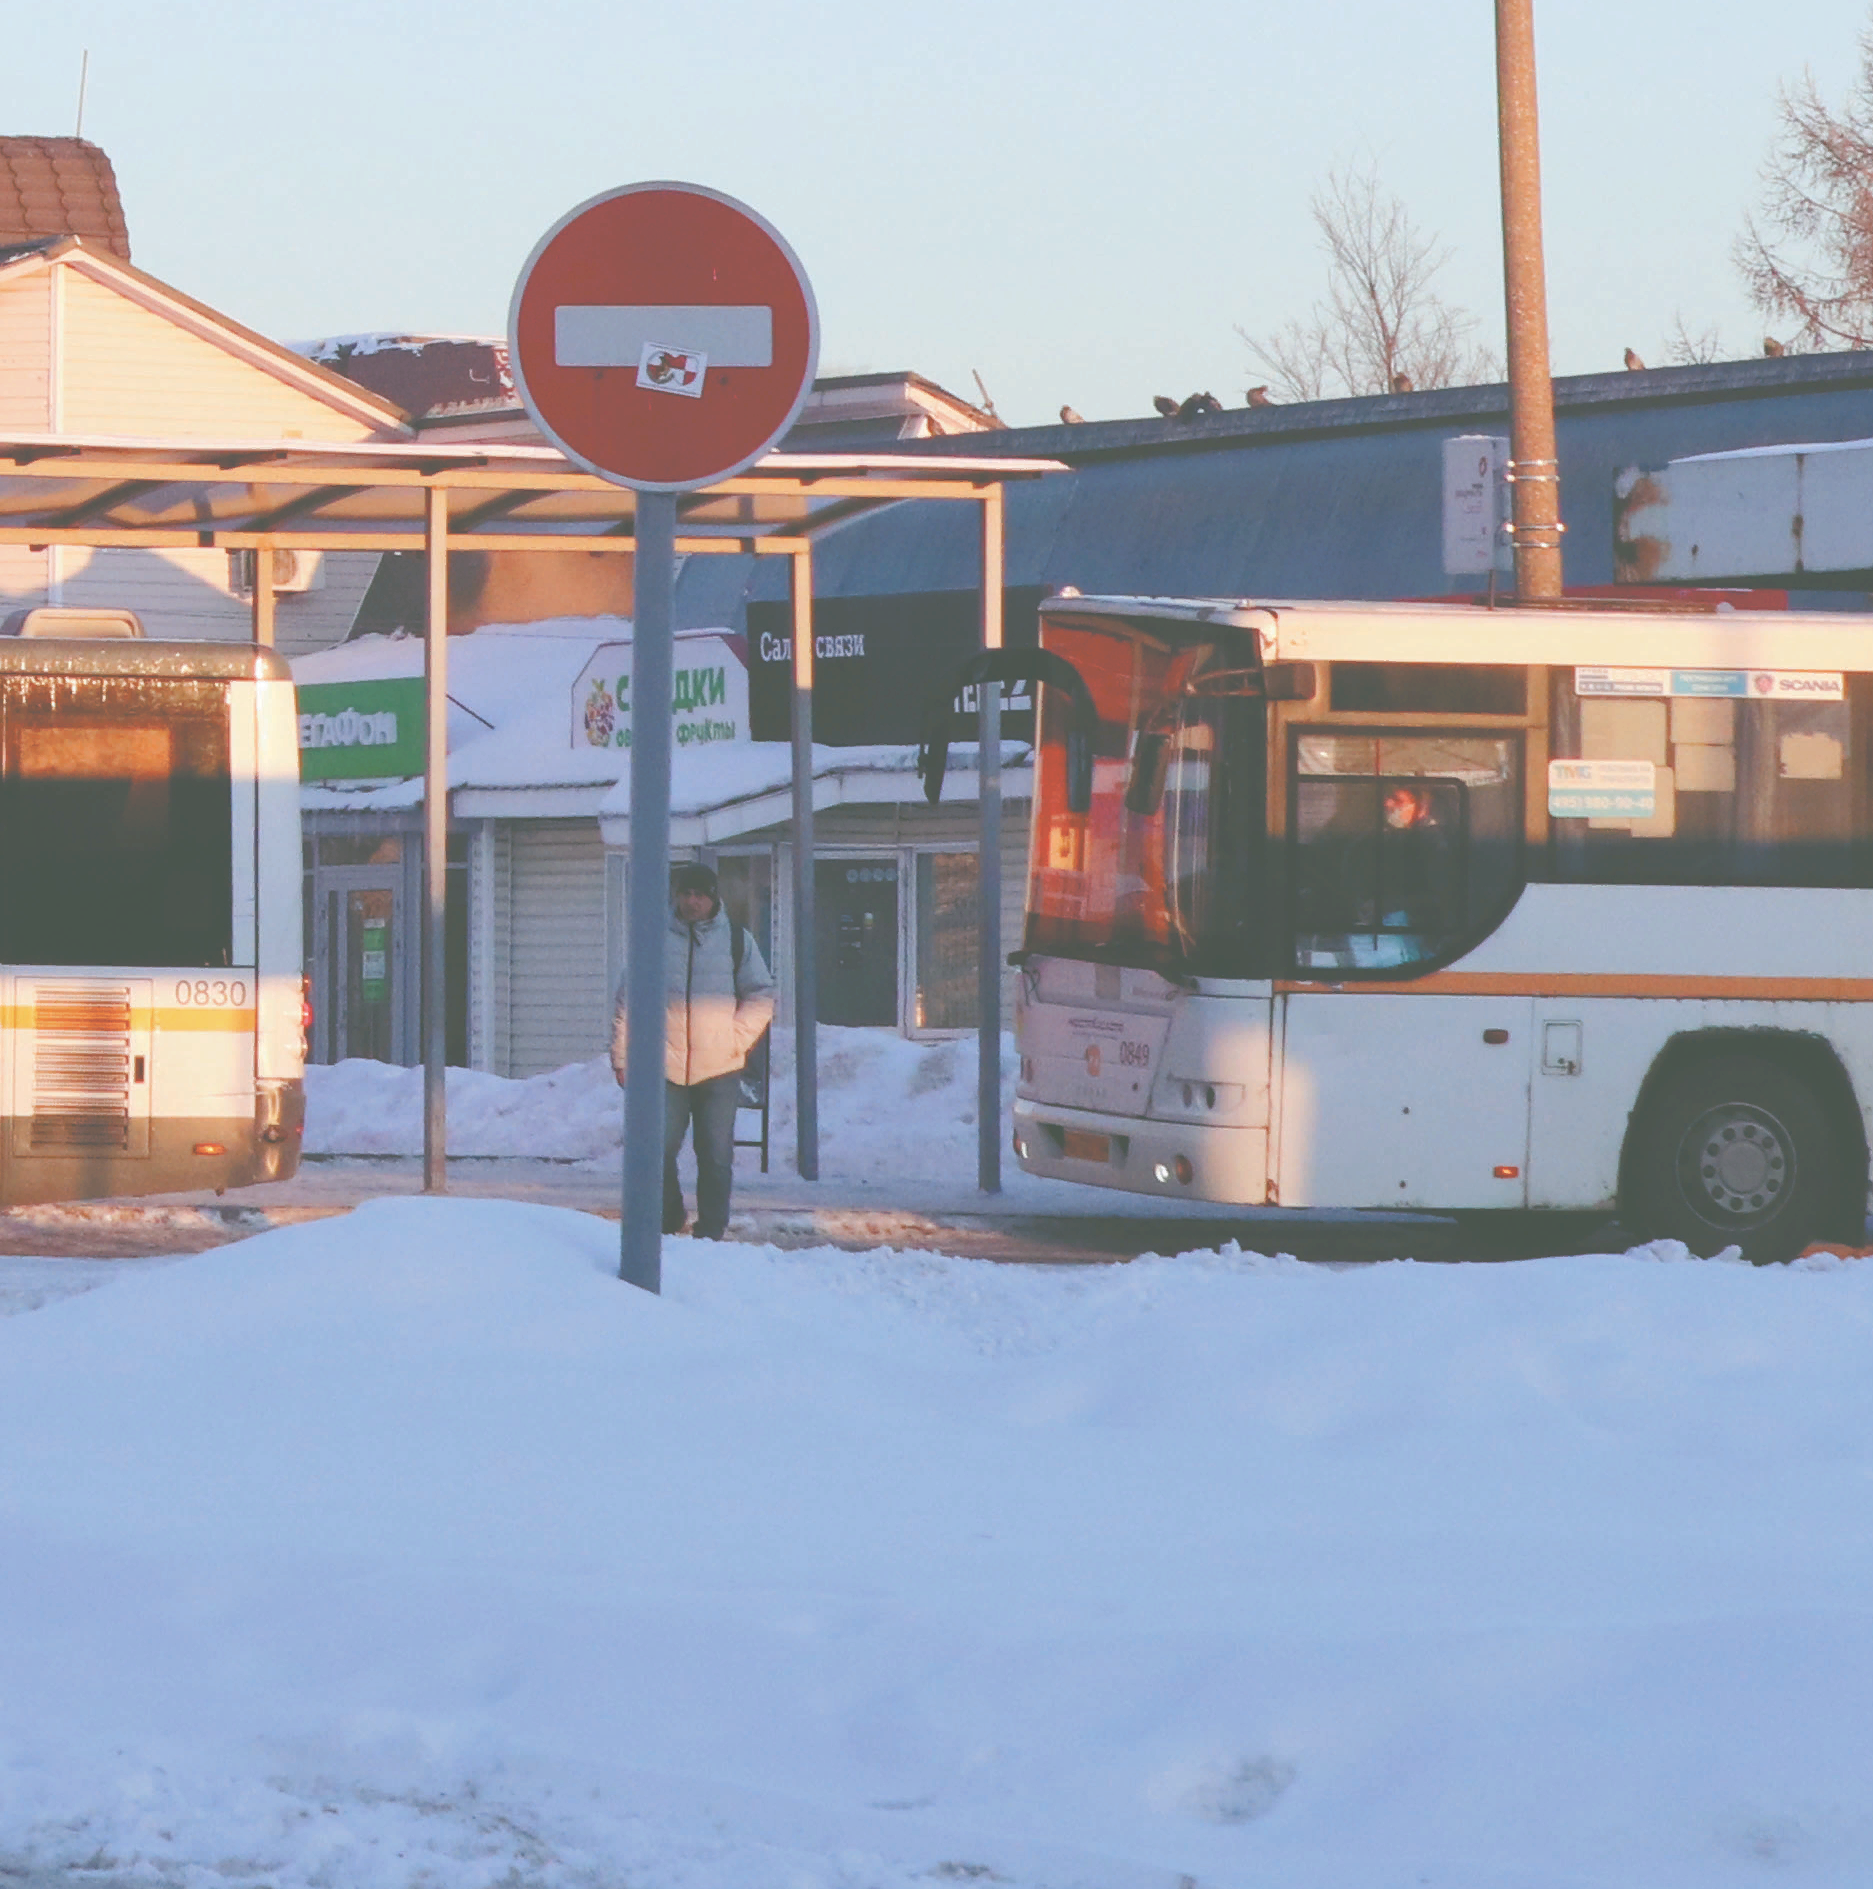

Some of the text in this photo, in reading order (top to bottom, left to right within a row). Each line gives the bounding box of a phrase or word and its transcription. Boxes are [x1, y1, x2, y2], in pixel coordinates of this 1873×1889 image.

[815, 634, 865, 659] связи
[1779, 678, 1841, 692] SCANIA
[298, 707, 398, 748] ЕГАФОН
[175, 979, 247, 1007] 0830
[1119, 1040, 1150, 1068] 0849
